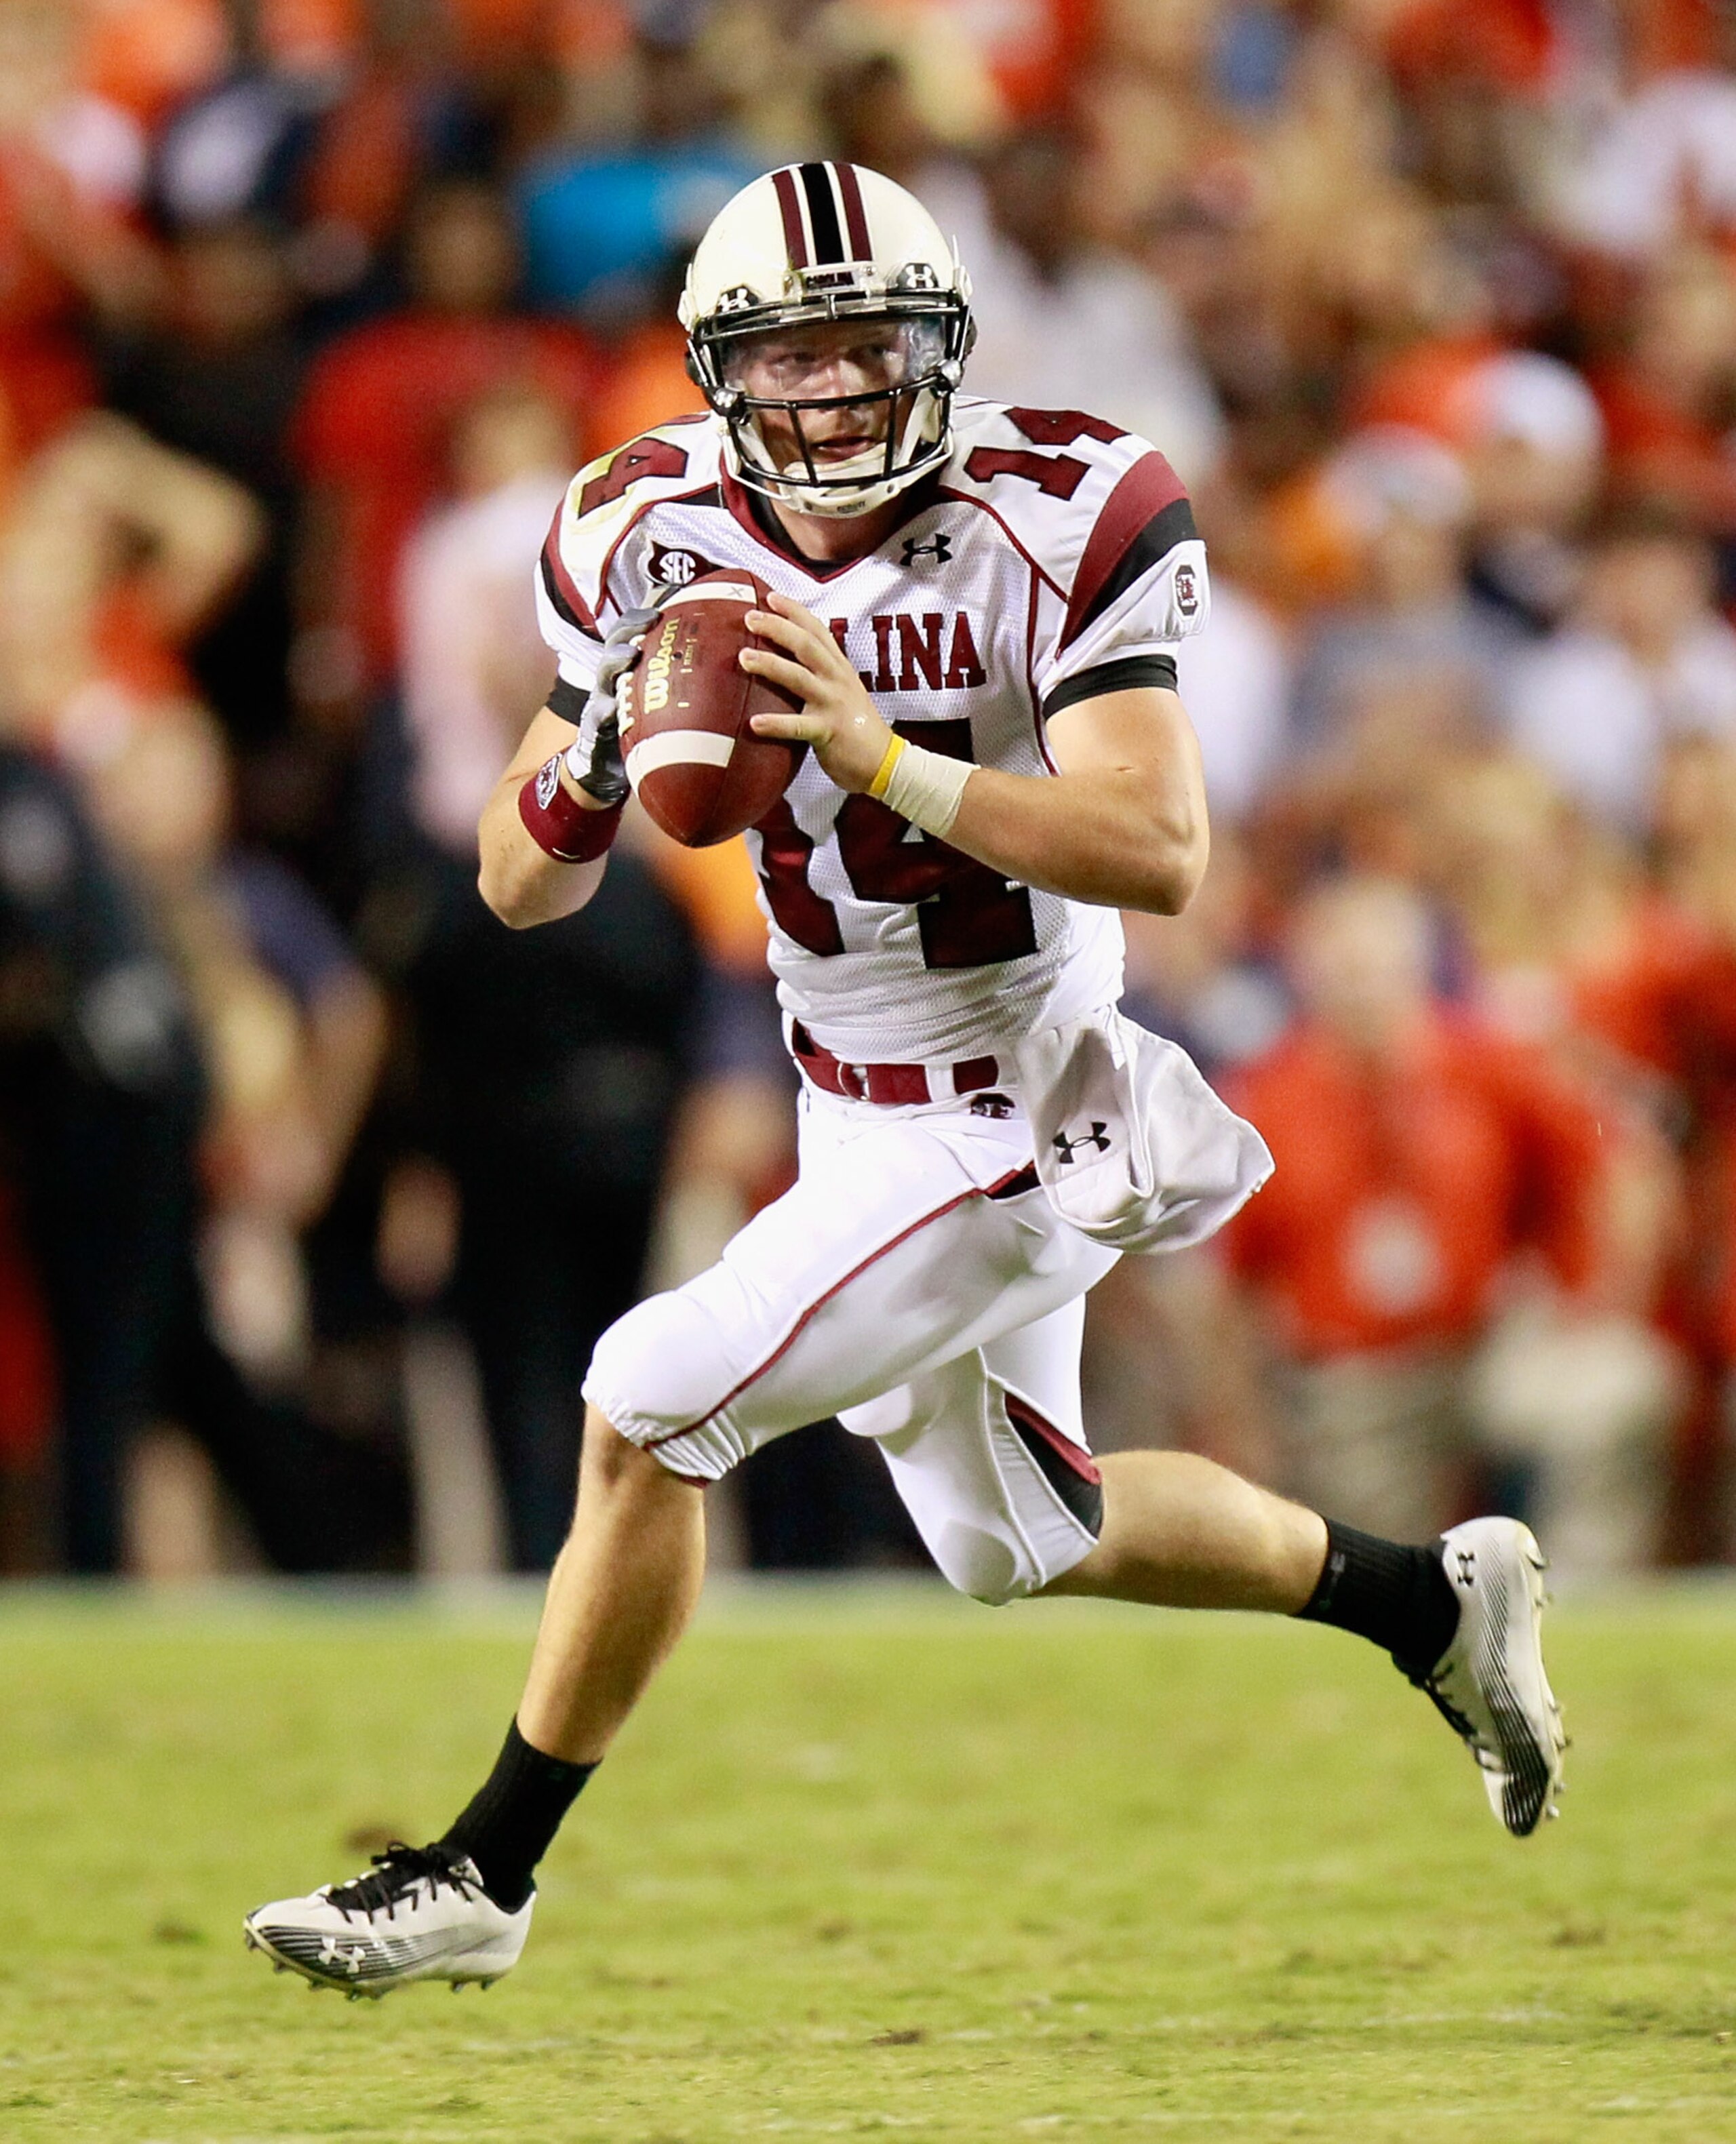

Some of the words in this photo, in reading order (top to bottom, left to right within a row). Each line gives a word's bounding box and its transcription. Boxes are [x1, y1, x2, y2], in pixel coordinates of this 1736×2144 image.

[578, 414, 711, 520] 4
[964, 407, 1132, 501] 14
[659, 551, 696, 584] SEC
[644, 618, 680, 715] Wilson
[829, 612, 987, 692] LINA
[747, 717, 1040, 969] 14
